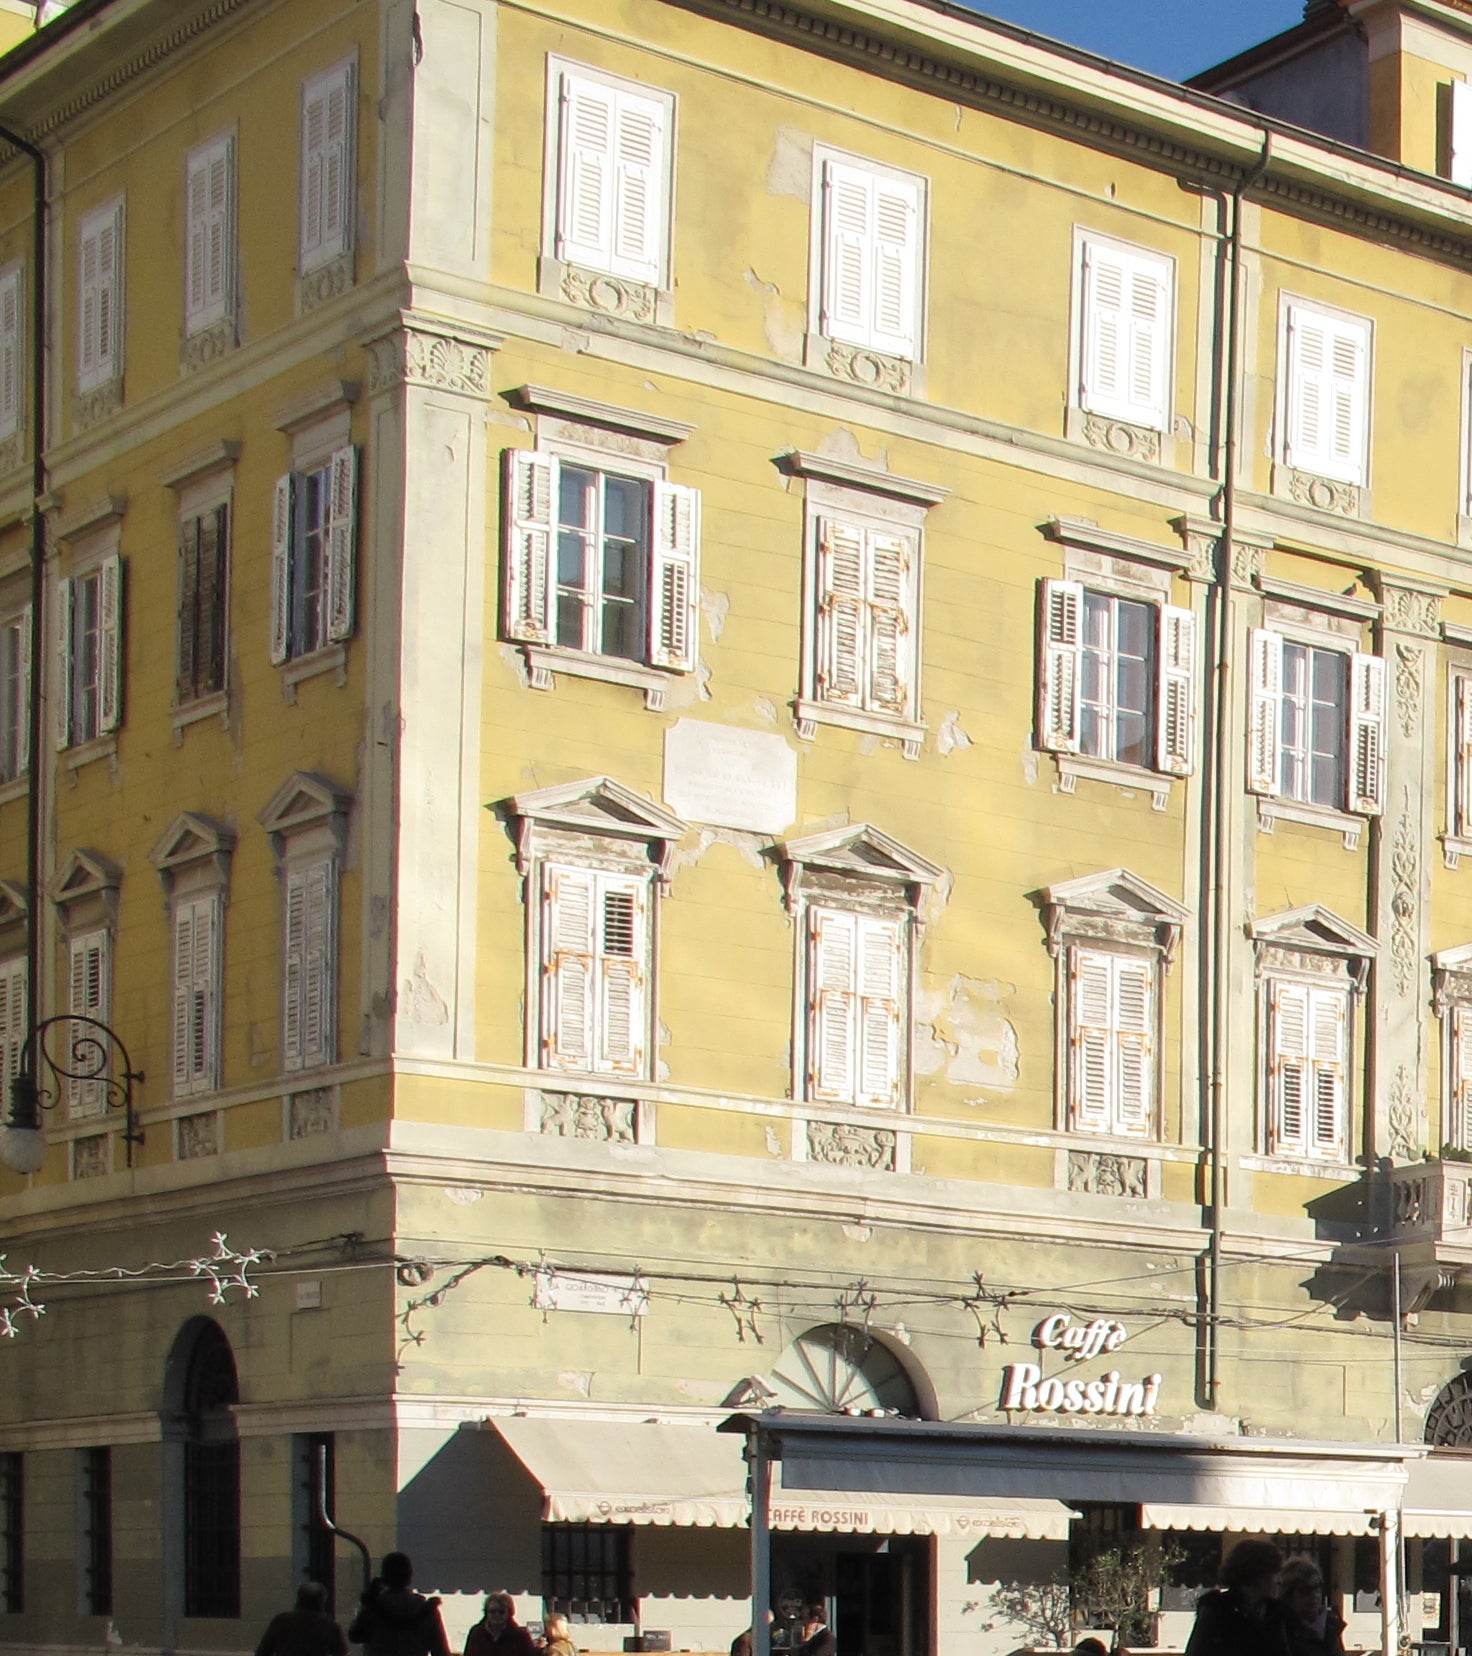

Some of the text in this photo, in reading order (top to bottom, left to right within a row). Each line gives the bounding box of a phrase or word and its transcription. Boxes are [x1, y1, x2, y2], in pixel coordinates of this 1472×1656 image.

[1037, 1313, 1128, 1361] Caffè
[1004, 1363, 1163, 1415] Rossini
[811, 1510, 869, 1526] ROSSINI
